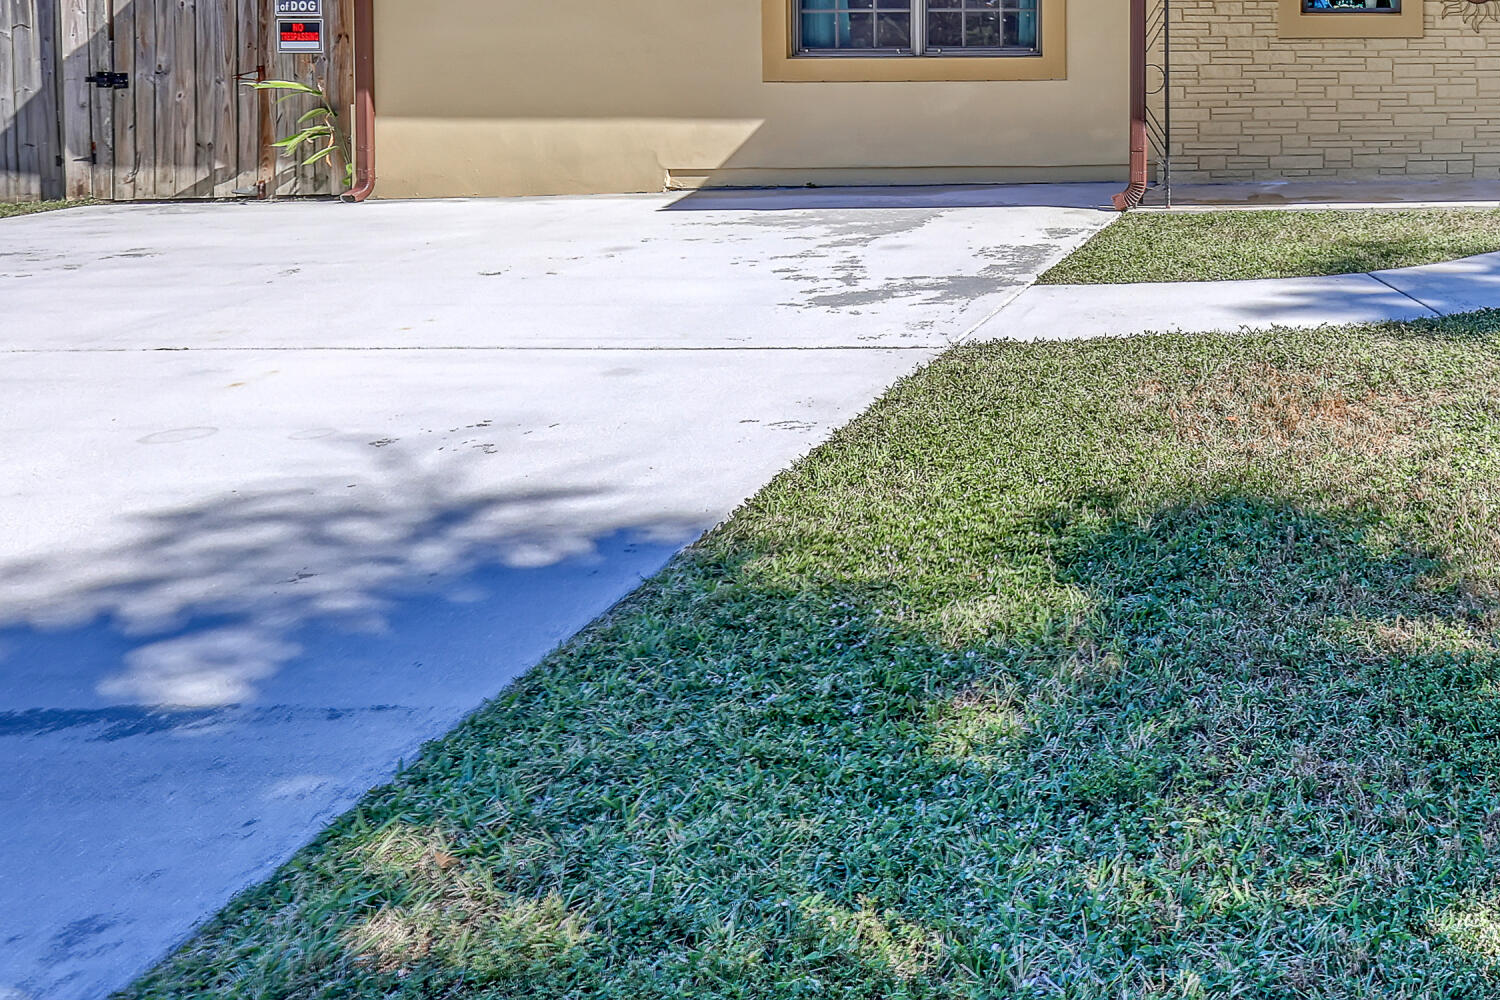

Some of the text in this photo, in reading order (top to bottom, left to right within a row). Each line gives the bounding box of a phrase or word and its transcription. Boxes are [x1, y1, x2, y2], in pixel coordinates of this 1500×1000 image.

[280, 1, 316, 11] of DOG
[292, 23, 304, 32] NO
